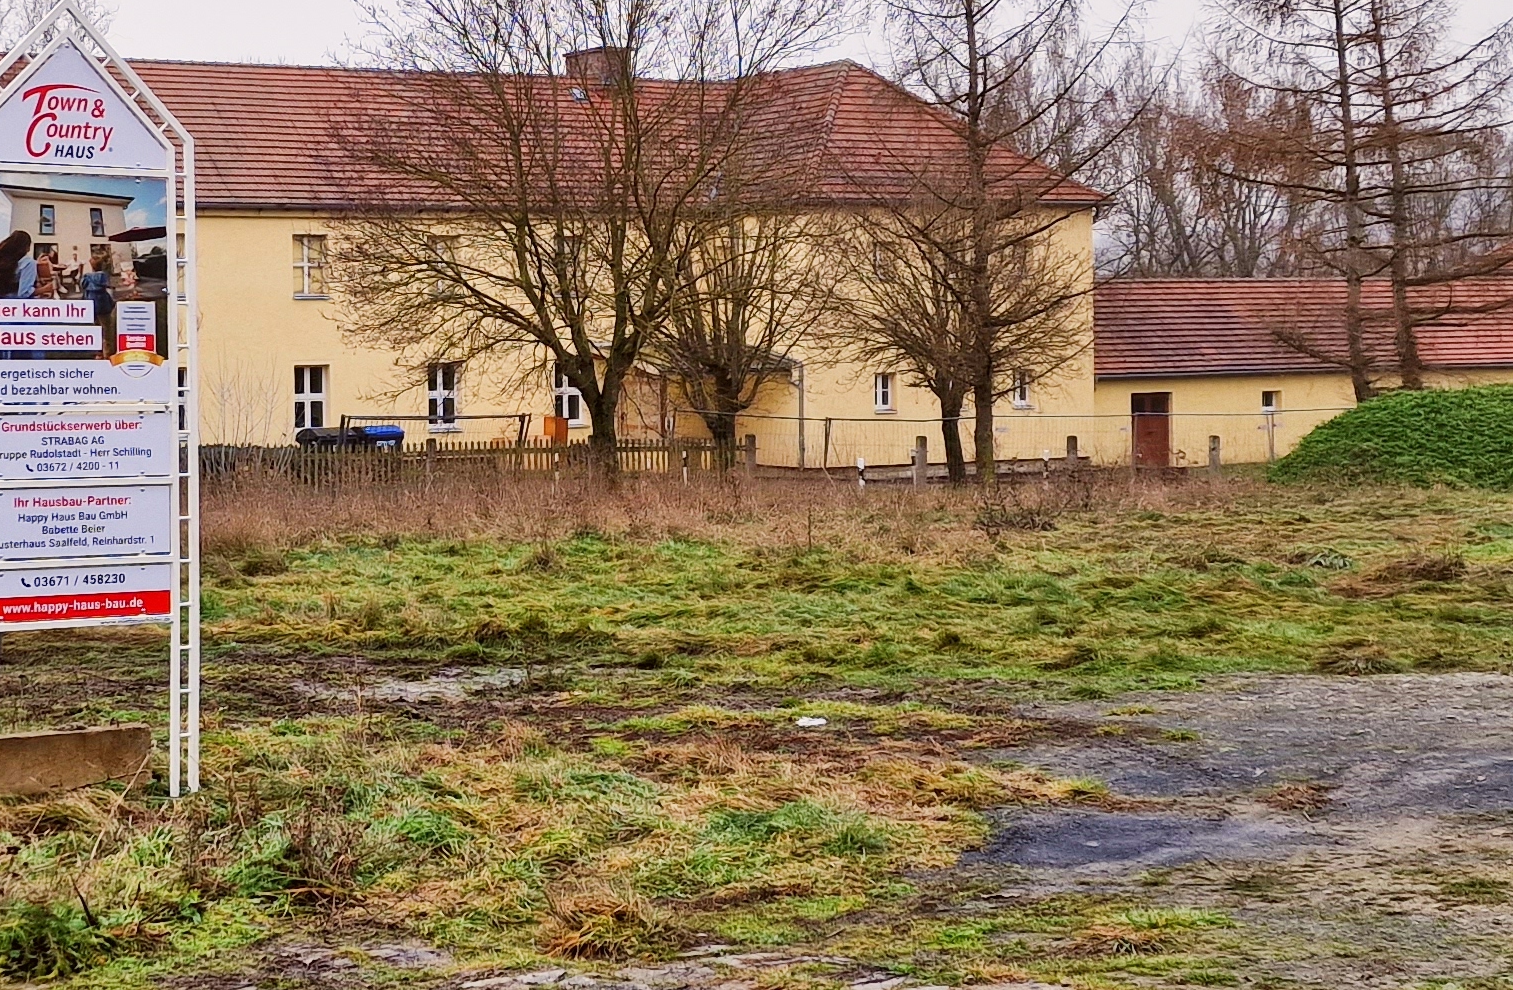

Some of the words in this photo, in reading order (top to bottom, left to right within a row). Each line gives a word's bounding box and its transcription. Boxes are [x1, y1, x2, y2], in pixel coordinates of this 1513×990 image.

[22, 84, 101, 117] Town
[91, 98, 105, 117] &
[26, 112, 113, 157] Country
[54, 144, 95, 159] HAUS
[22, 303, 61, 318] kann
[66, 303, 86, 318] Ihr
[41, 331, 94, 346] stehen
[59, 369, 94, 379] sicher
[11, 385, 69, 396] bezahlbar
[73, 385, 121, 395] wohnen.
[1, 420, 111, 432] Grundstückserwerb
[115, 420, 143, 430] über:
[41, 436, 88, 446] STRABAG
[91, 436, 105, 445] AG
[30, 449, 81, 459] Rudolstadt
[90, 449, 109, 457] Herr
[112, 447, 152, 458] Schilling
[37, 463, 67, 472] 03672
[108, 461, 120, 470] 11
[14, 498, 29, 508] Ihr
[32, 496, 132, 507] Hausbau-Partner:
[18, 513, 49, 524] Happy
[51, 513, 75, 521] Haus
[78, 512, 97, 521] Bau
[99, 511, 128, 520] GmbH
[42, 526, 79, 535] Babette
[81, 524, 105, 533] Beier
[48, 537, 90, 548] Saalfeld,
[150, 535, 155, 544] 1
[34, 576, 69, 587] 03671
[82, 573, 126, 585] 458230
[3, 597, 143, 614] www.happy-haus-bau.de
